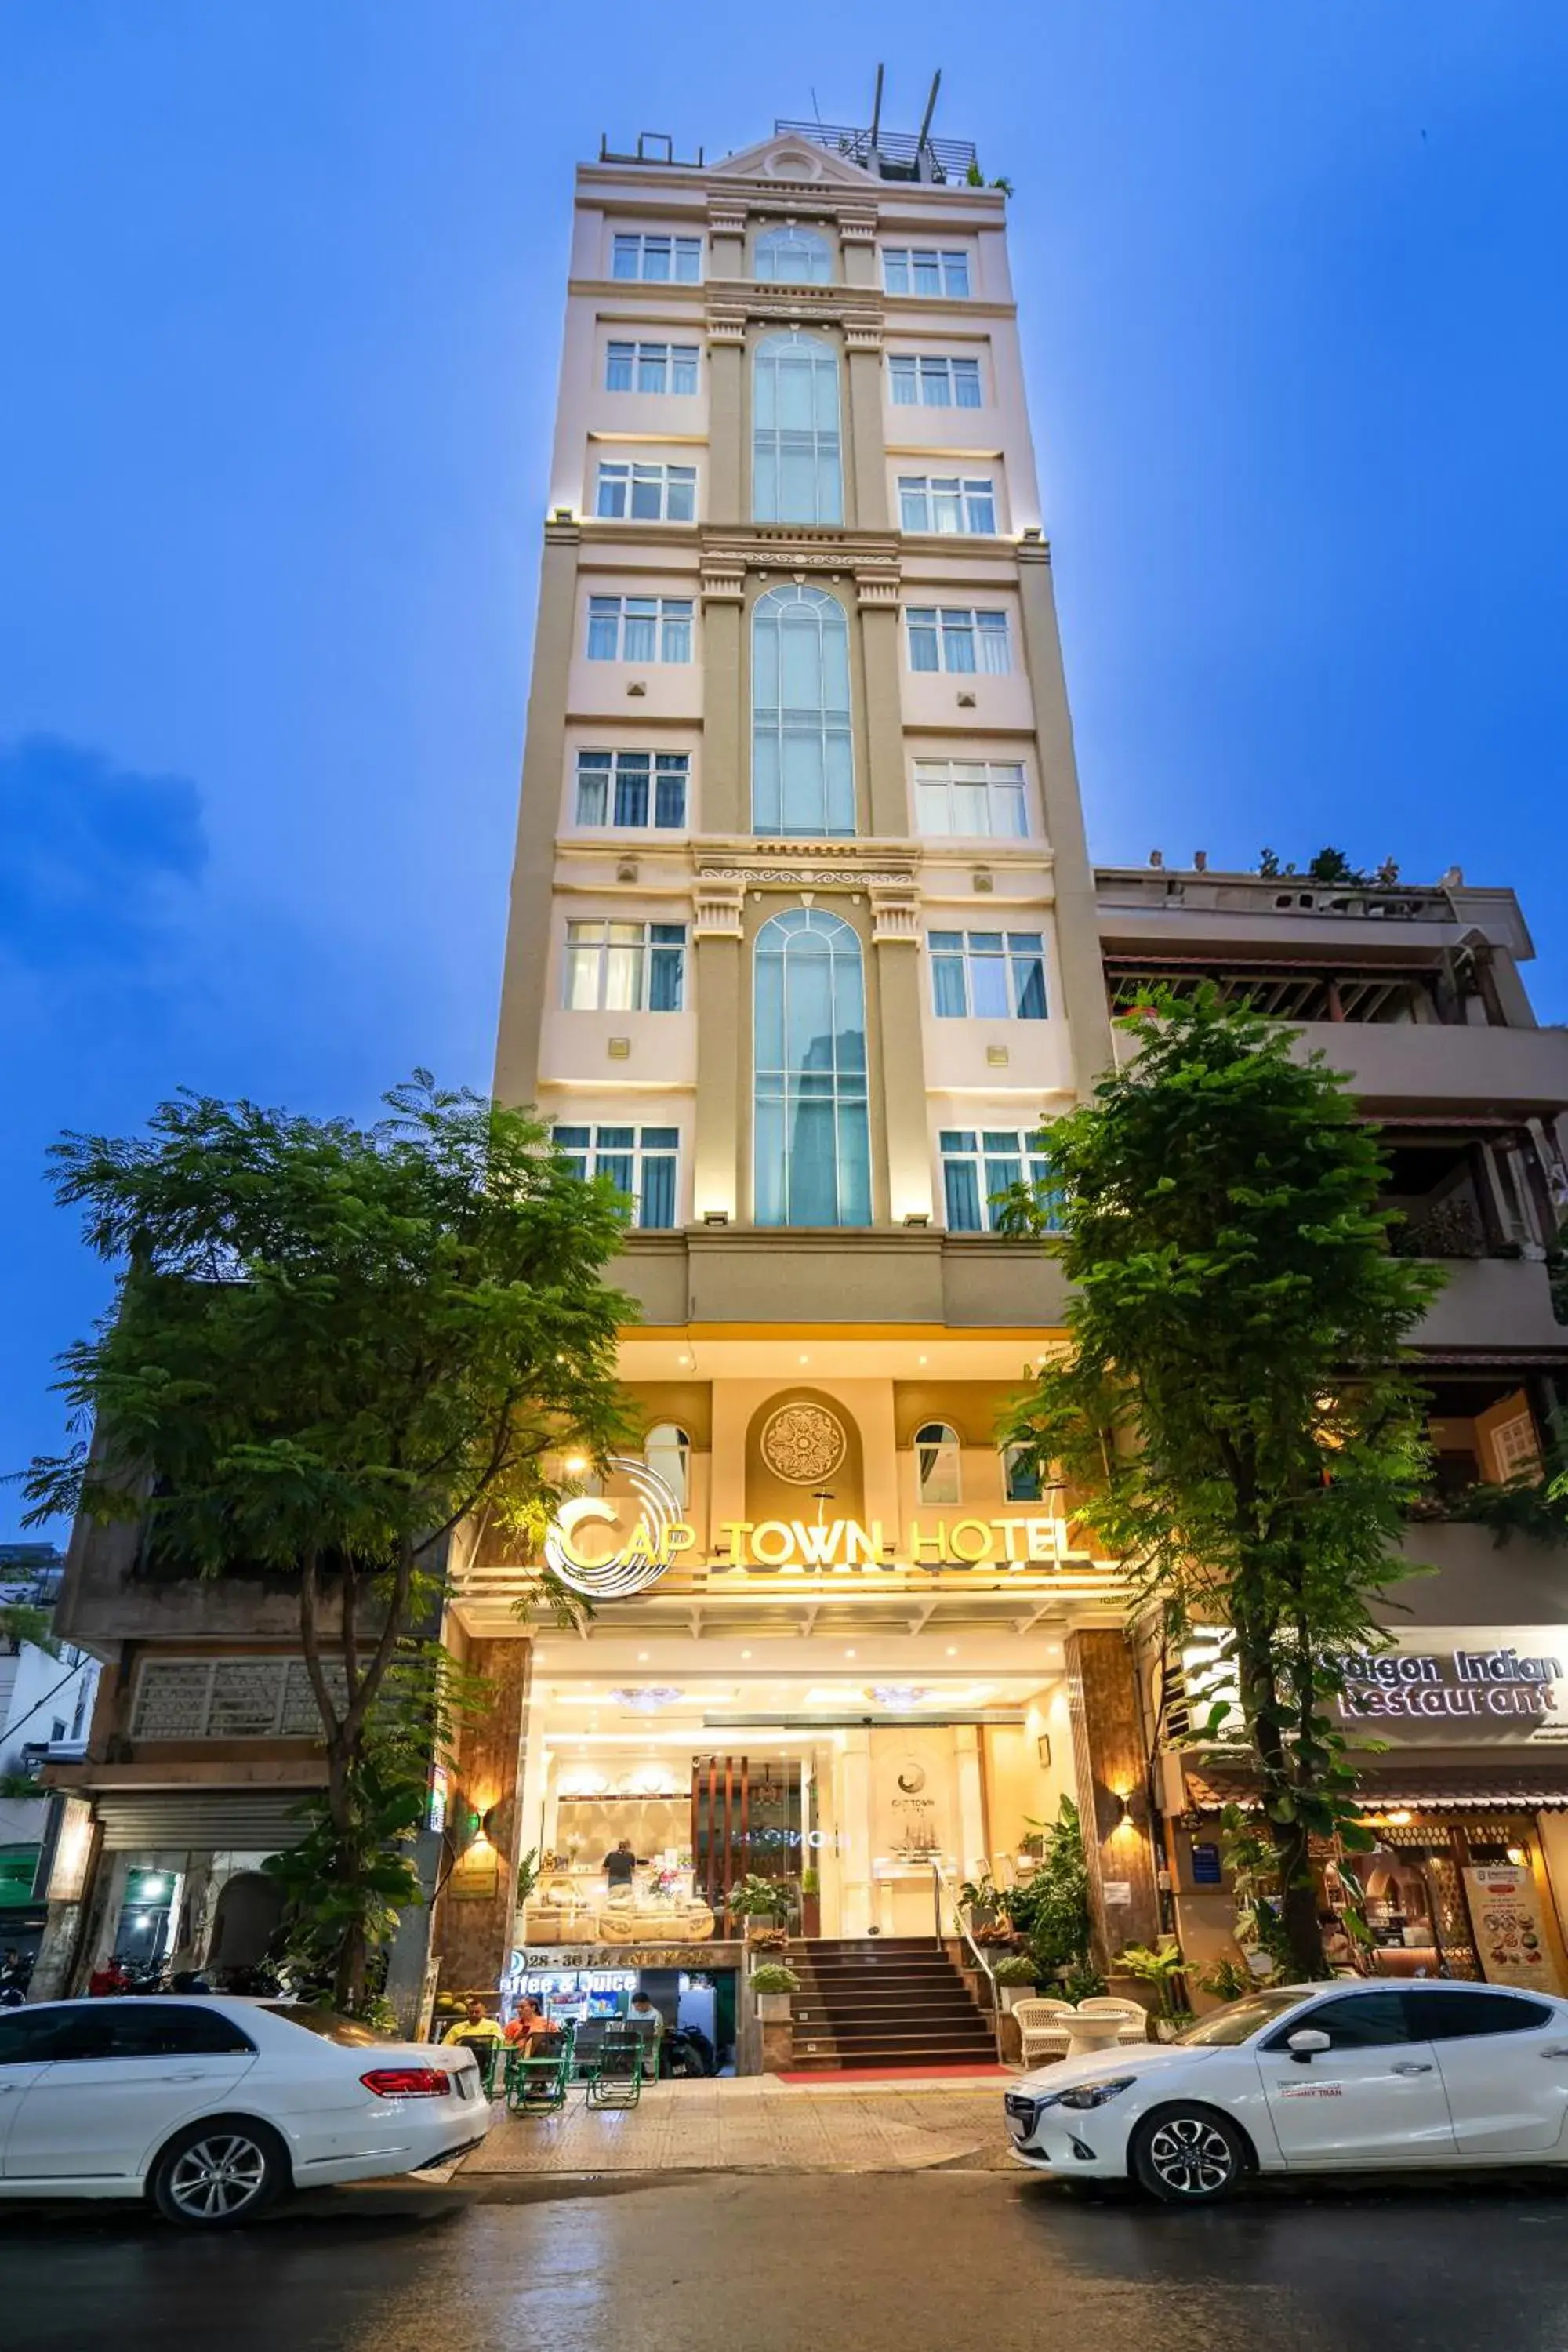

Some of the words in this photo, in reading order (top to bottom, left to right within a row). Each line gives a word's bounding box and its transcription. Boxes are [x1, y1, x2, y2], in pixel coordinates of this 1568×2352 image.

[559, 1497, 696, 1568] CAP
[720, 1519, 883, 1565] TOWN
[910, 1516, 1091, 1563] HOTEL
[1454, 1647, 1563, 1682] Indian
[1337, 1683, 1558, 1717] Restaurant
[529, 1953, 550, 1968] 28
[558, 1976, 576, 1994] &
[580, 1973, 637, 1992] Juice
